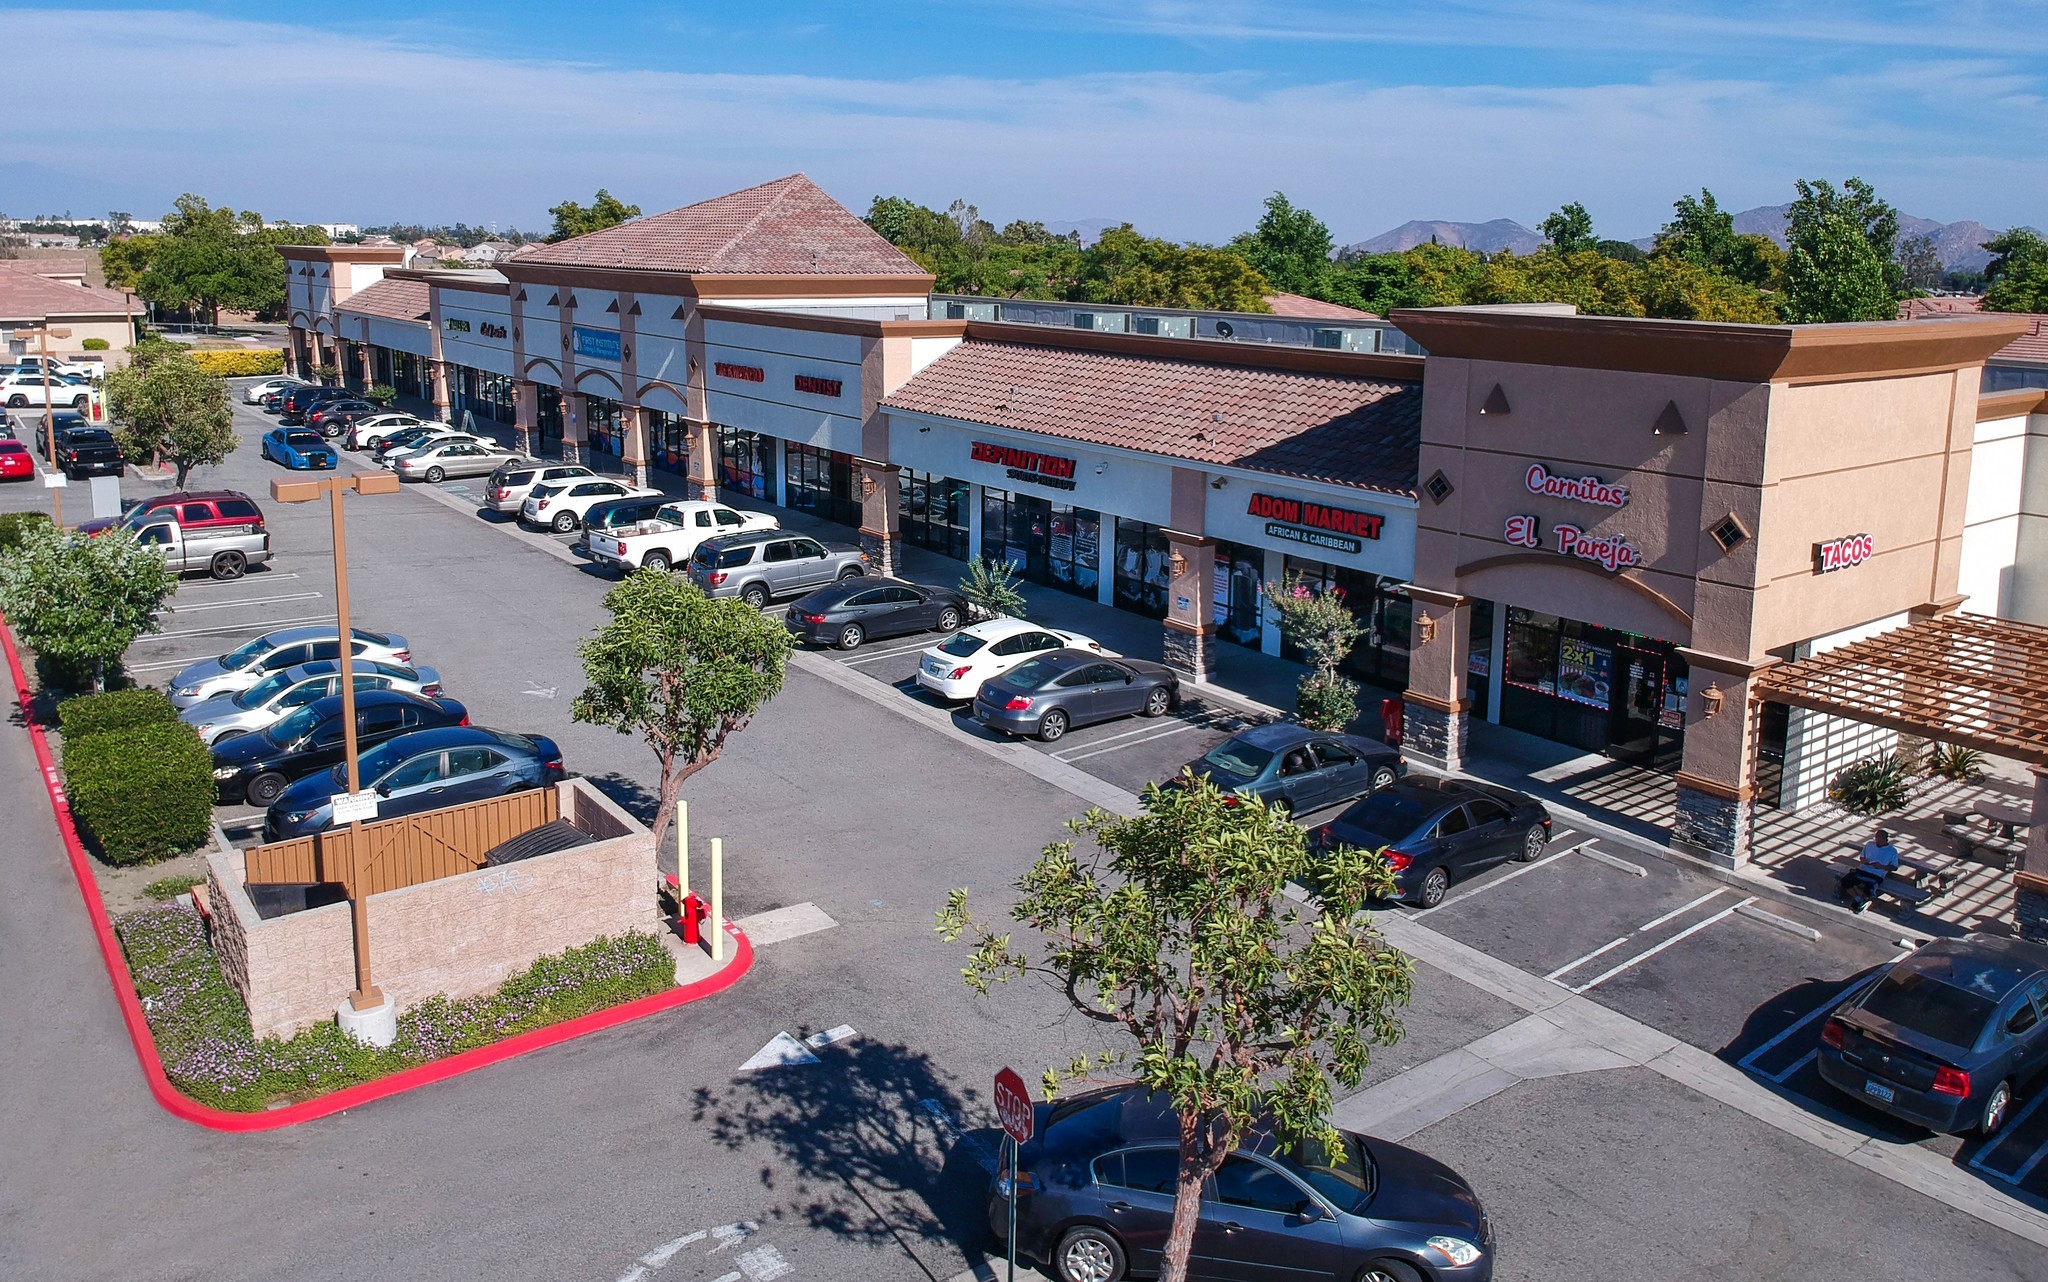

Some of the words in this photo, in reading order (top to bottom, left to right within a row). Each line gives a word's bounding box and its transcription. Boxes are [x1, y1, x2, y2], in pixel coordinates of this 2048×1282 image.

[581, 335, 595, 345] FIRST
[596, 337, 620, 350] INSTITUTE
[795, 375, 842, 397] DENTIST
[970, 441, 1077, 479] DEFINITION
[1526, 464, 1625, 507] Carnitas
[1248, 493, 1300, 523] ADOM
[1303, 502, 1384, 540] MARKET
[1268, 525, 1300, 540] AFRICAN
[1302, 532, 1308, 542] &
[1309, 534, 1355, 552] CARIBBEAN
[1505, 516, 1537, 547] El
[1555, 525, 1635, 570] Pareja
[1820, 534, 1873, 570] TACOS
[1562, 645, 1594, 665] 2x1
[335, 792, 375, 806] WARNING
[996, 1082, 1031, 1124] STOP
